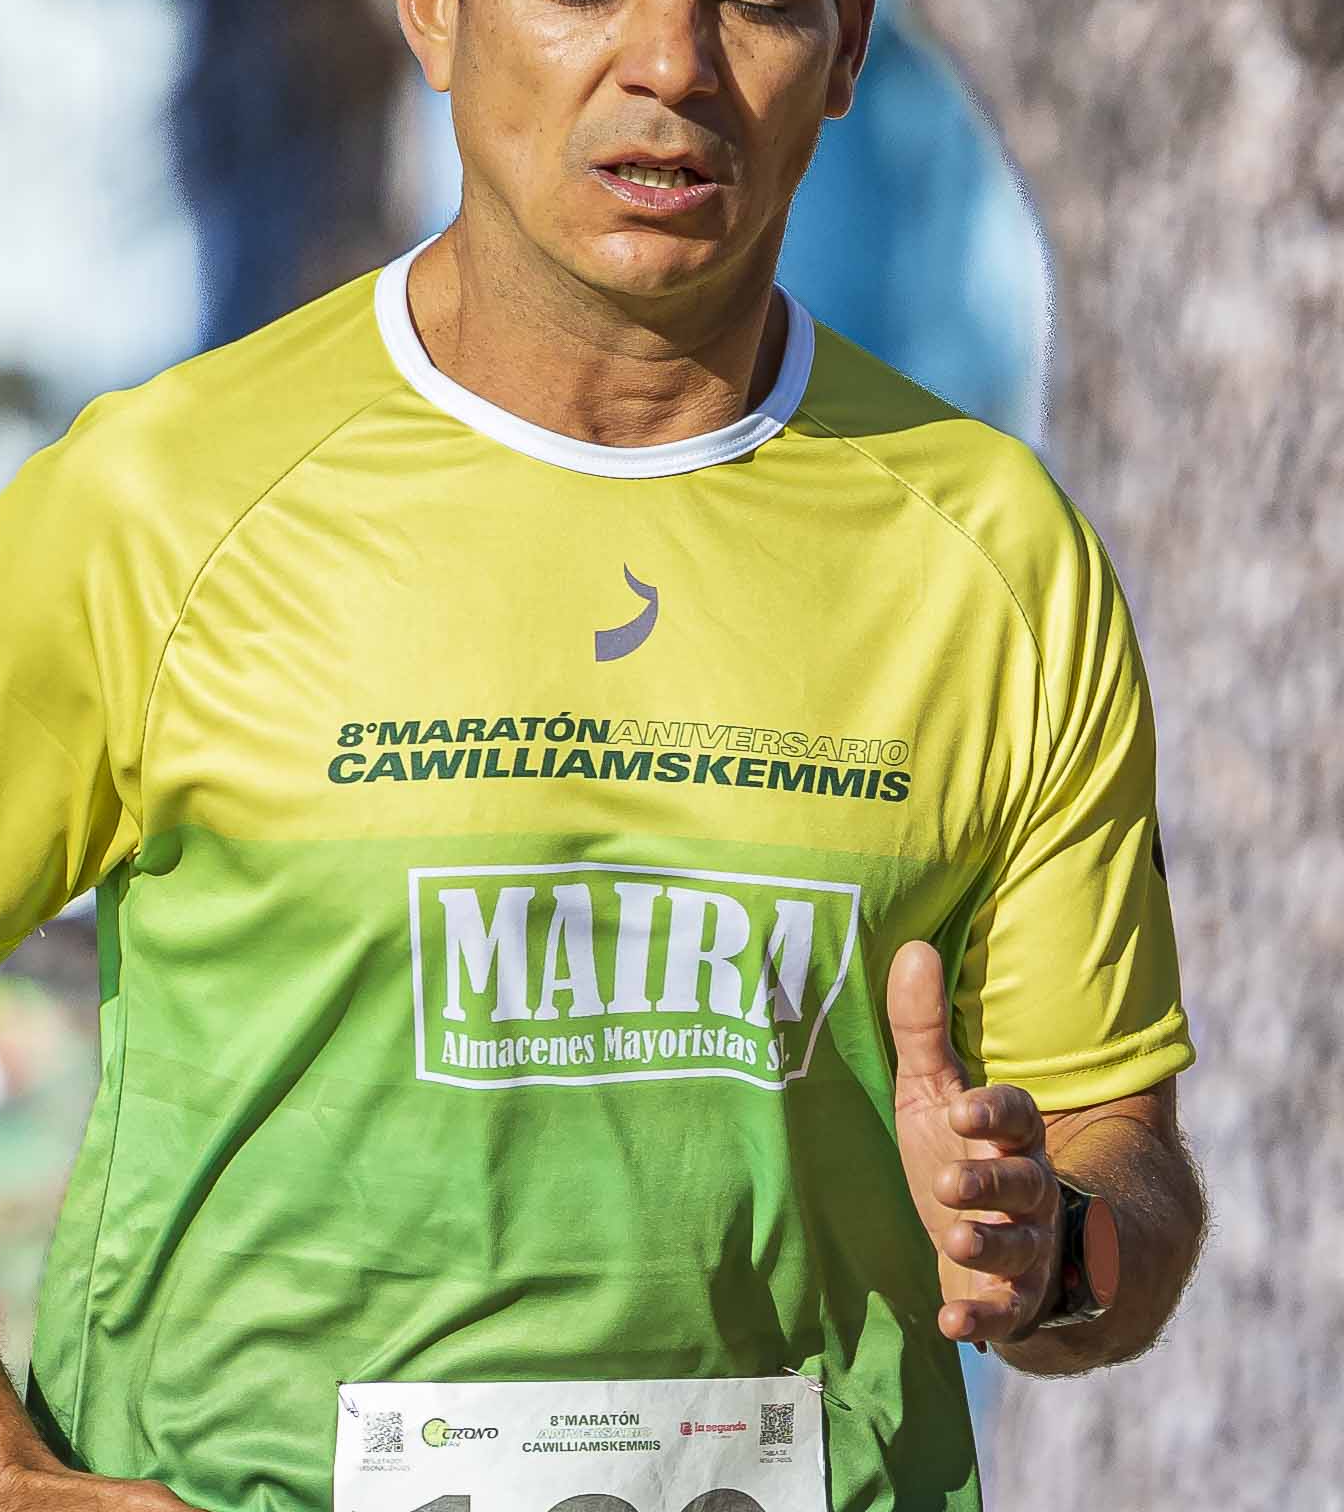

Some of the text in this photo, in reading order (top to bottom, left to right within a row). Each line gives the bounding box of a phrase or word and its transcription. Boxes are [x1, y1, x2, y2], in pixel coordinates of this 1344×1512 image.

[328, 747, 912, 802] CAWILLIAMSKEMMIS
[438, 882, 814, 1028] MAIRA
[442, 1031, 594, 1069] Almacenes
[602, 1024, 757, 1068] Mayoristas
[522, 1440, 661, 1453] CAWILLIAMSKEMMIS
